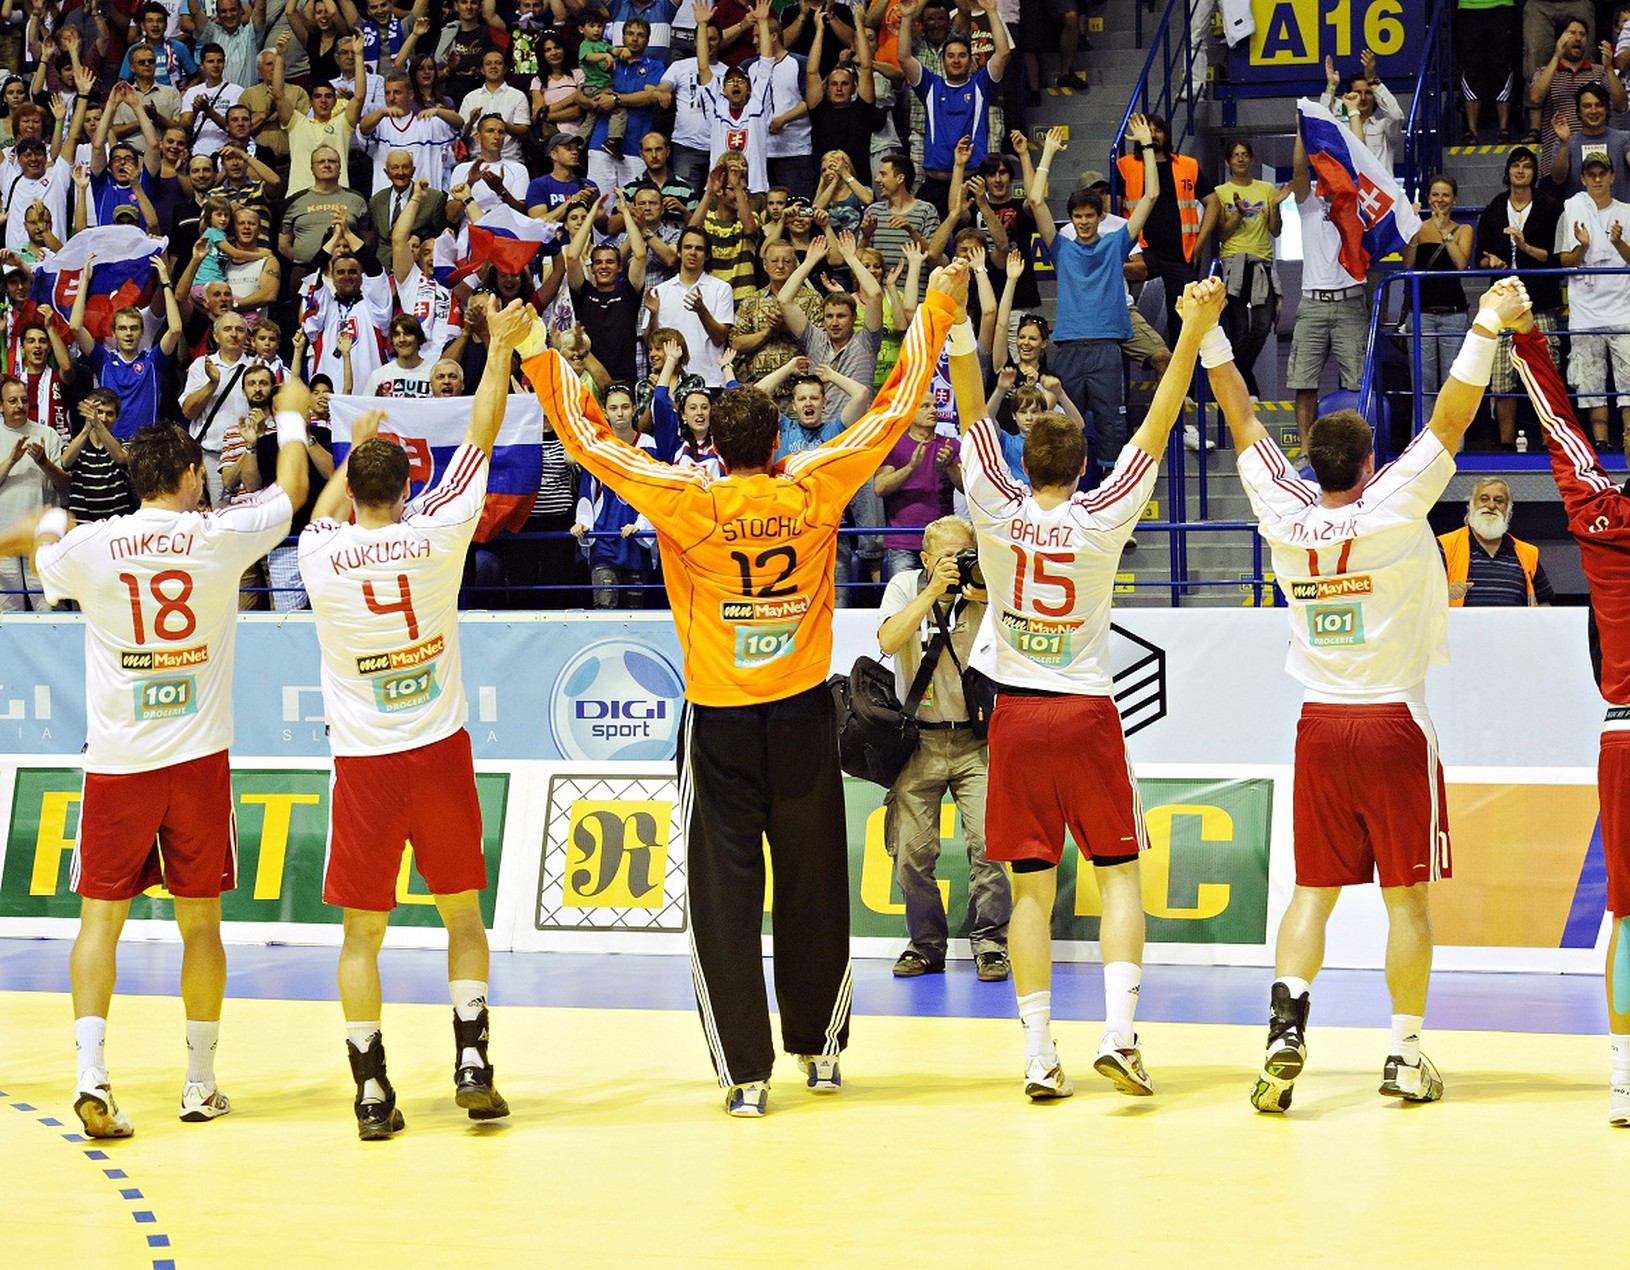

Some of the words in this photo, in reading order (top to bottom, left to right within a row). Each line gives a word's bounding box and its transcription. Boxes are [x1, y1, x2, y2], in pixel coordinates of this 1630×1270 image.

[1261, 3, 1308, 59] A
[1325, 0, 1405, 56] 16
[109, 532, 194, 560] MIKECI
[330, 538, 431, 575] KUKUCKA
[730, 546, 798, 597] 12
[1010, 544, 1076, 617] 15
[119, 569, 196, 645] 18
[362, 574, 419, 640] 4
[755, 601, 807, 618] MayNet
[1315, 613, 1353, 632] 101
[747, 633, 790, 654] 101
[1020, 634, 1062, 653] 101
[146, 683, 187, 705] 101
[385, 673, 429, 699] 101
[576, 700, 666, 719] DIGI
[592, 721, 650, 740] sport
